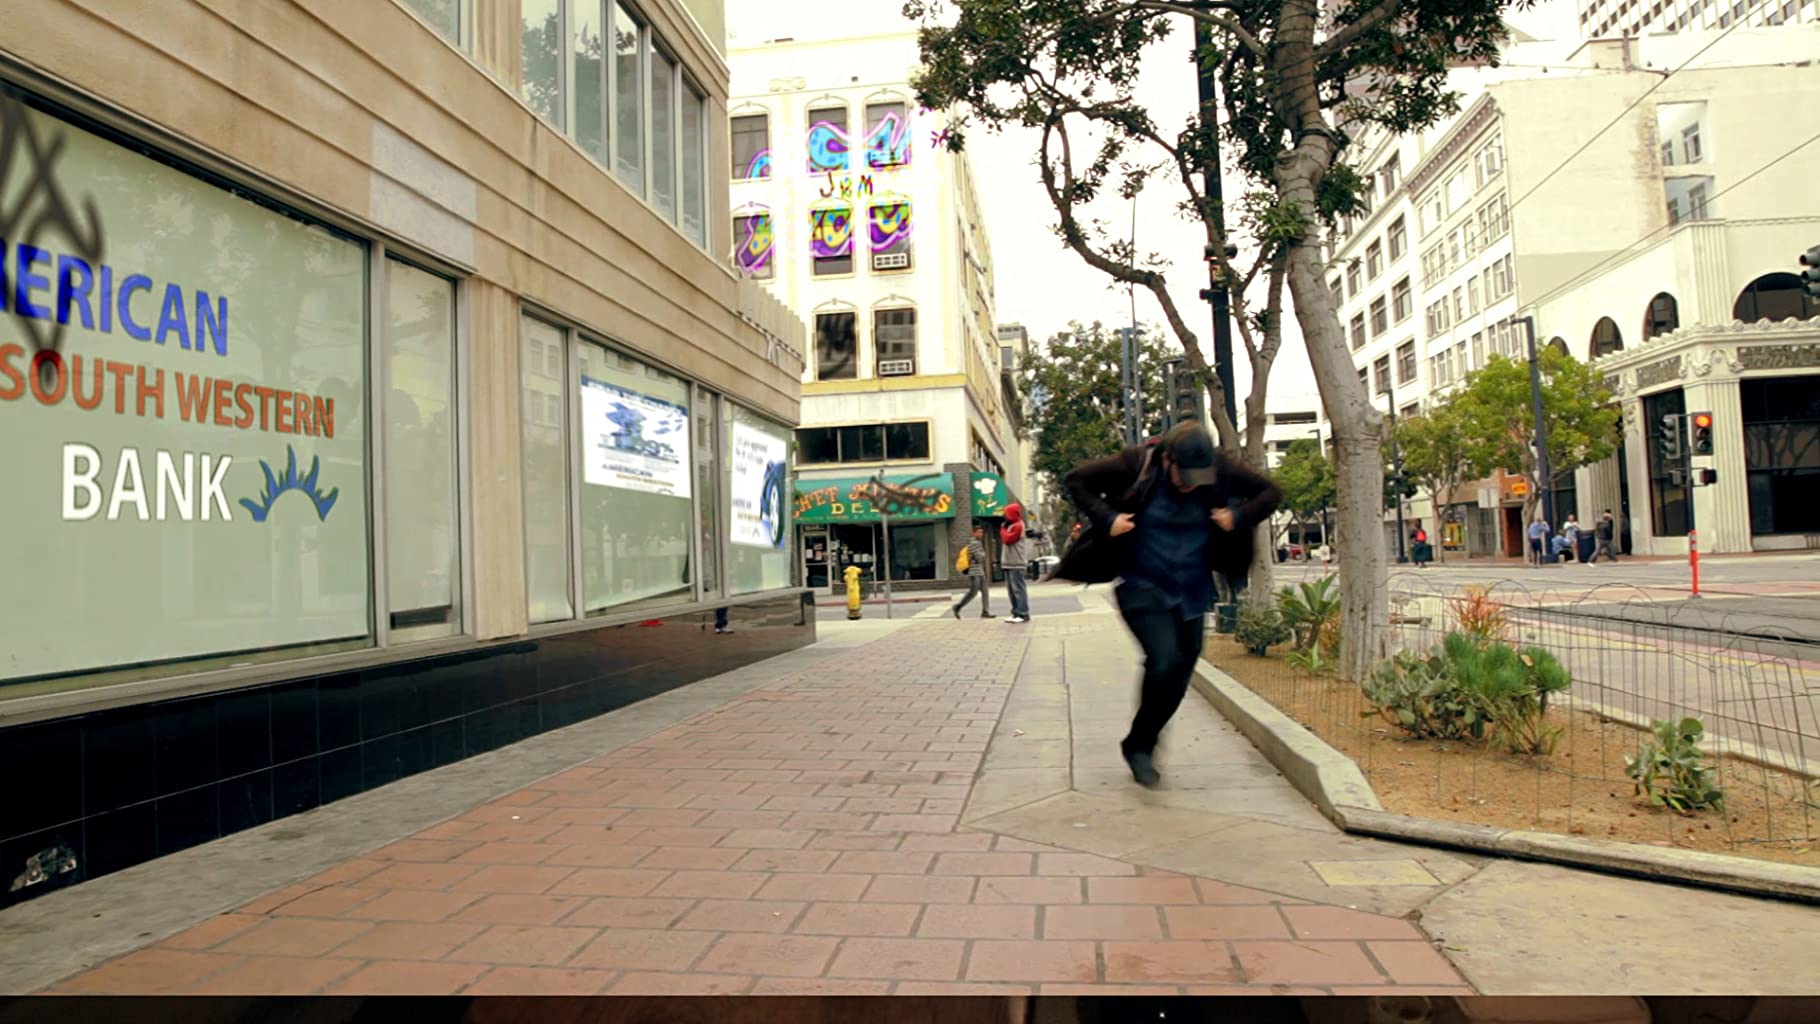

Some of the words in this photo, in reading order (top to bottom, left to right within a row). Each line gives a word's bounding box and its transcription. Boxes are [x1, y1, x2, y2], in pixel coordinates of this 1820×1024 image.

[0, 236, 228, 357] ERICAN
[0, 343, 164, 419] SOUTH
[175, 371, 335, 439] WESTERN
[61, 441, 234, 522] BANK
[831, 502, 891, 515] DEL
